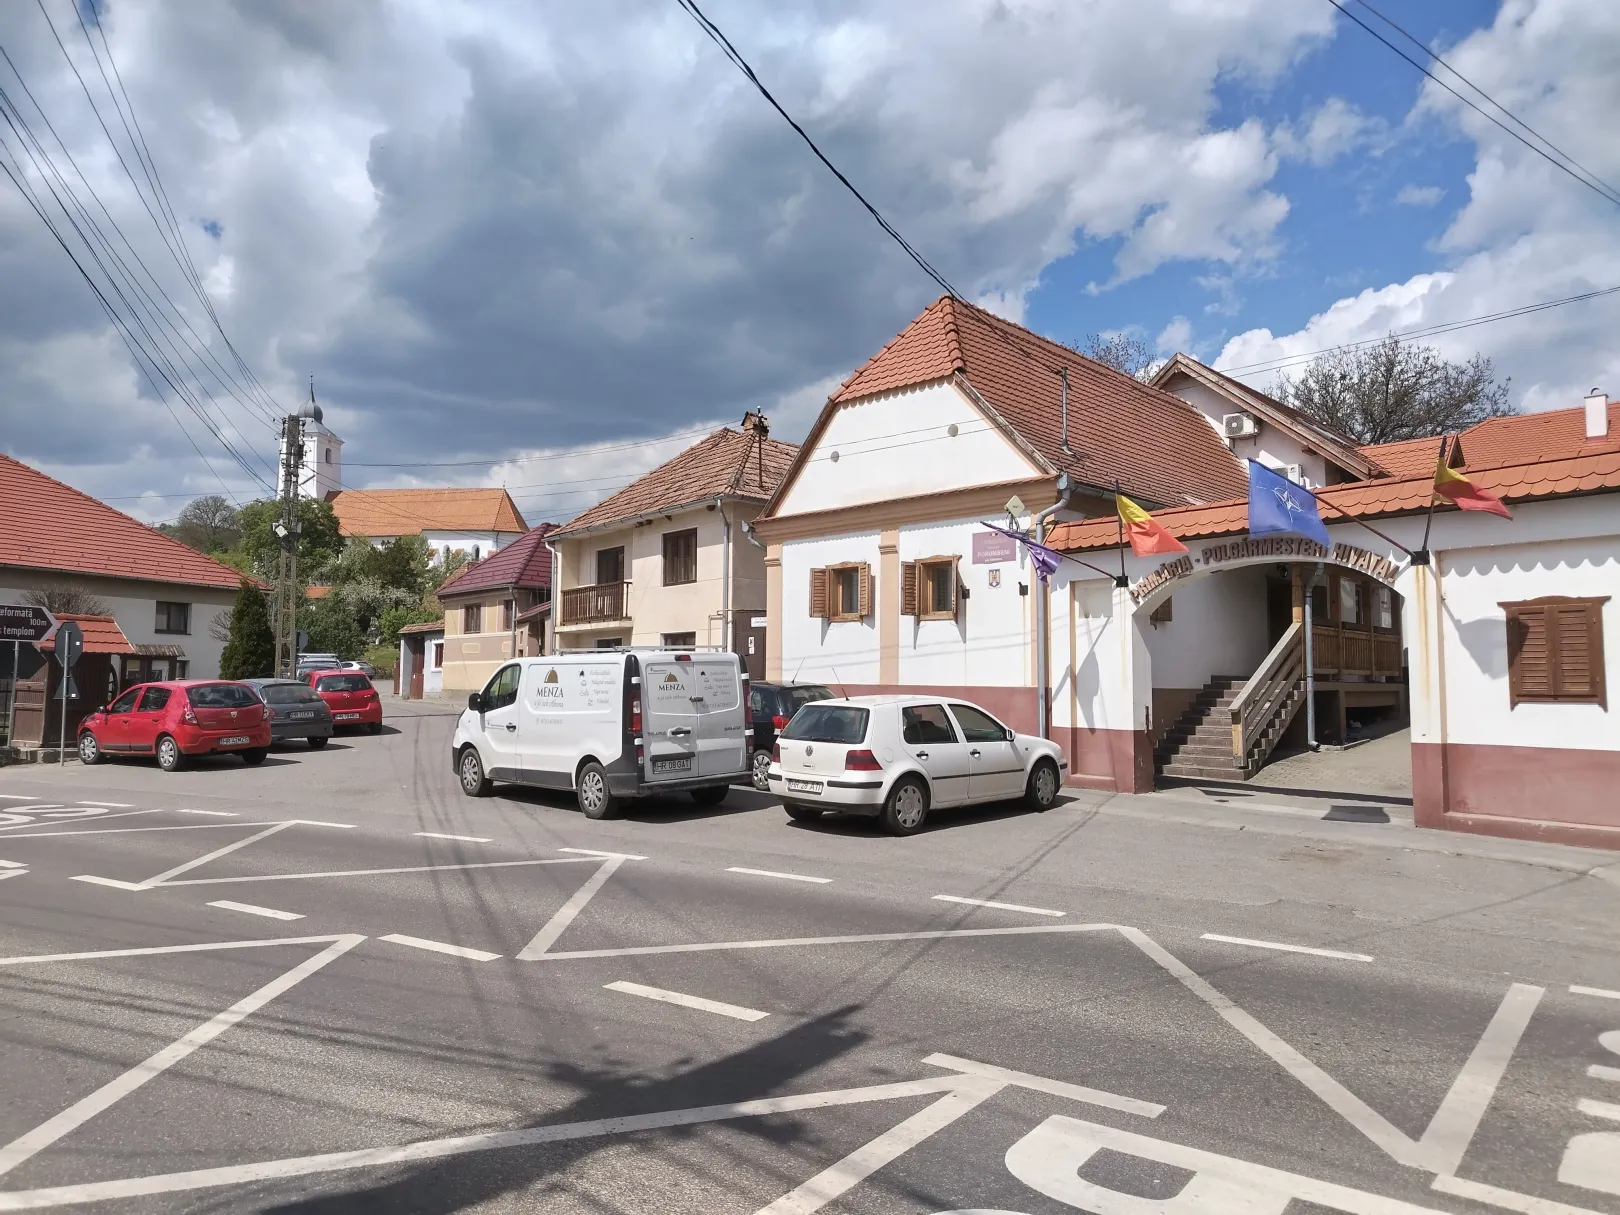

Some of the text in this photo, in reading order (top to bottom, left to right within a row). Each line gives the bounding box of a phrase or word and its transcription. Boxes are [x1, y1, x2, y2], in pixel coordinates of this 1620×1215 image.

[0, 607, 33, 618] eformată
[3, 625, 35, 637] templom
[536, 686, 564, 698] MENZA
[658, 683, 686, 692] MENZA
